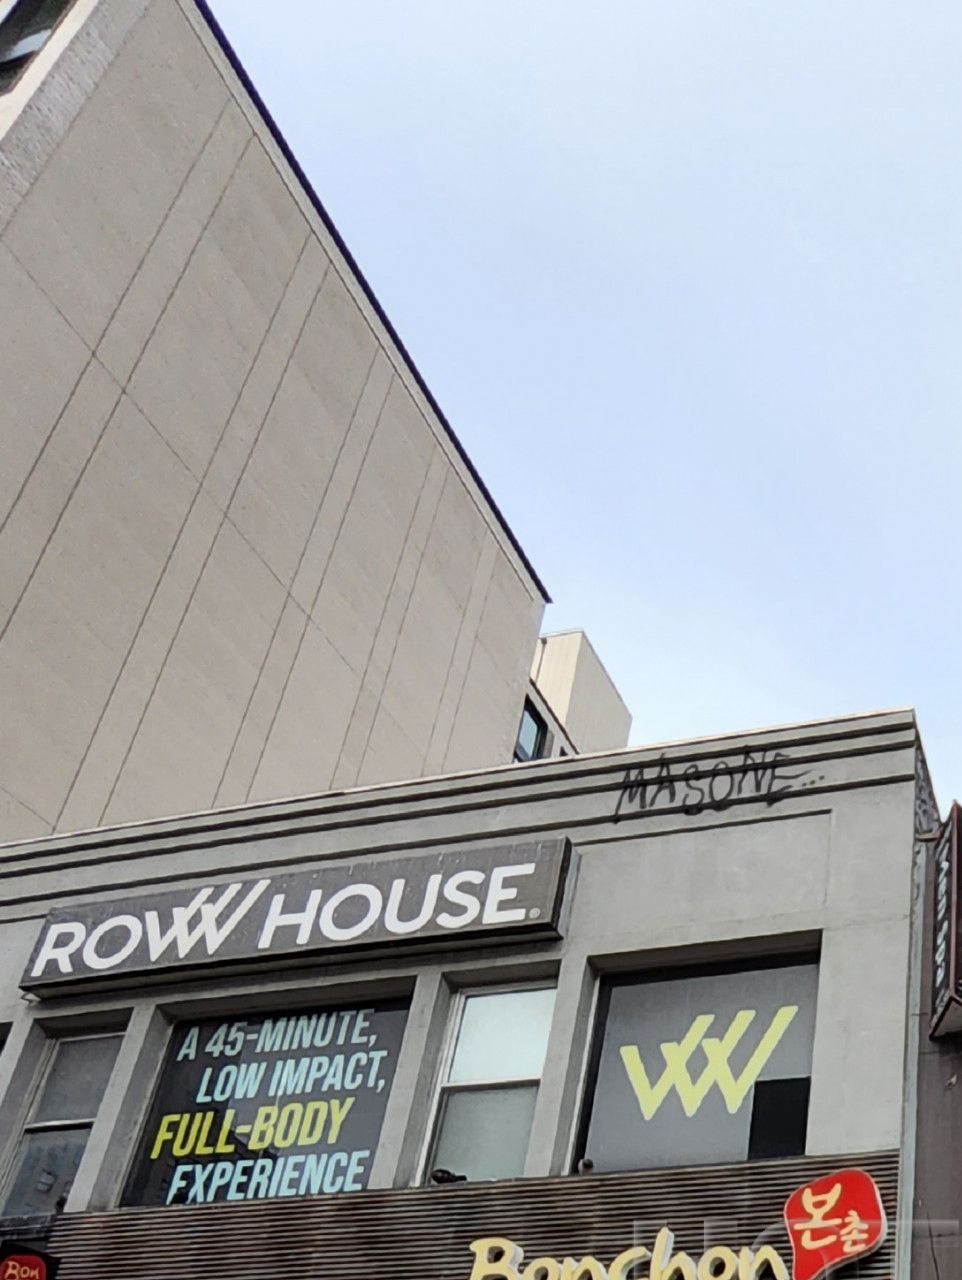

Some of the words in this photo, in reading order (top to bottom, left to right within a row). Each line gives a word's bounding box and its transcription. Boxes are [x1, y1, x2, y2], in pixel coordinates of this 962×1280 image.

[257, 863, 536, 950] HOUSE
[176, 1026, 200, 1061] A
[204, 1008, 379, 1058] 45-MINUTE,
[196, 1061, 268, 1104] LOW
[267, 1050, 389, 1093] IMPACT,
[150, 1097, 356, 1160] FULL-BODY
[793, 1183, 870, 1253] 본촌
